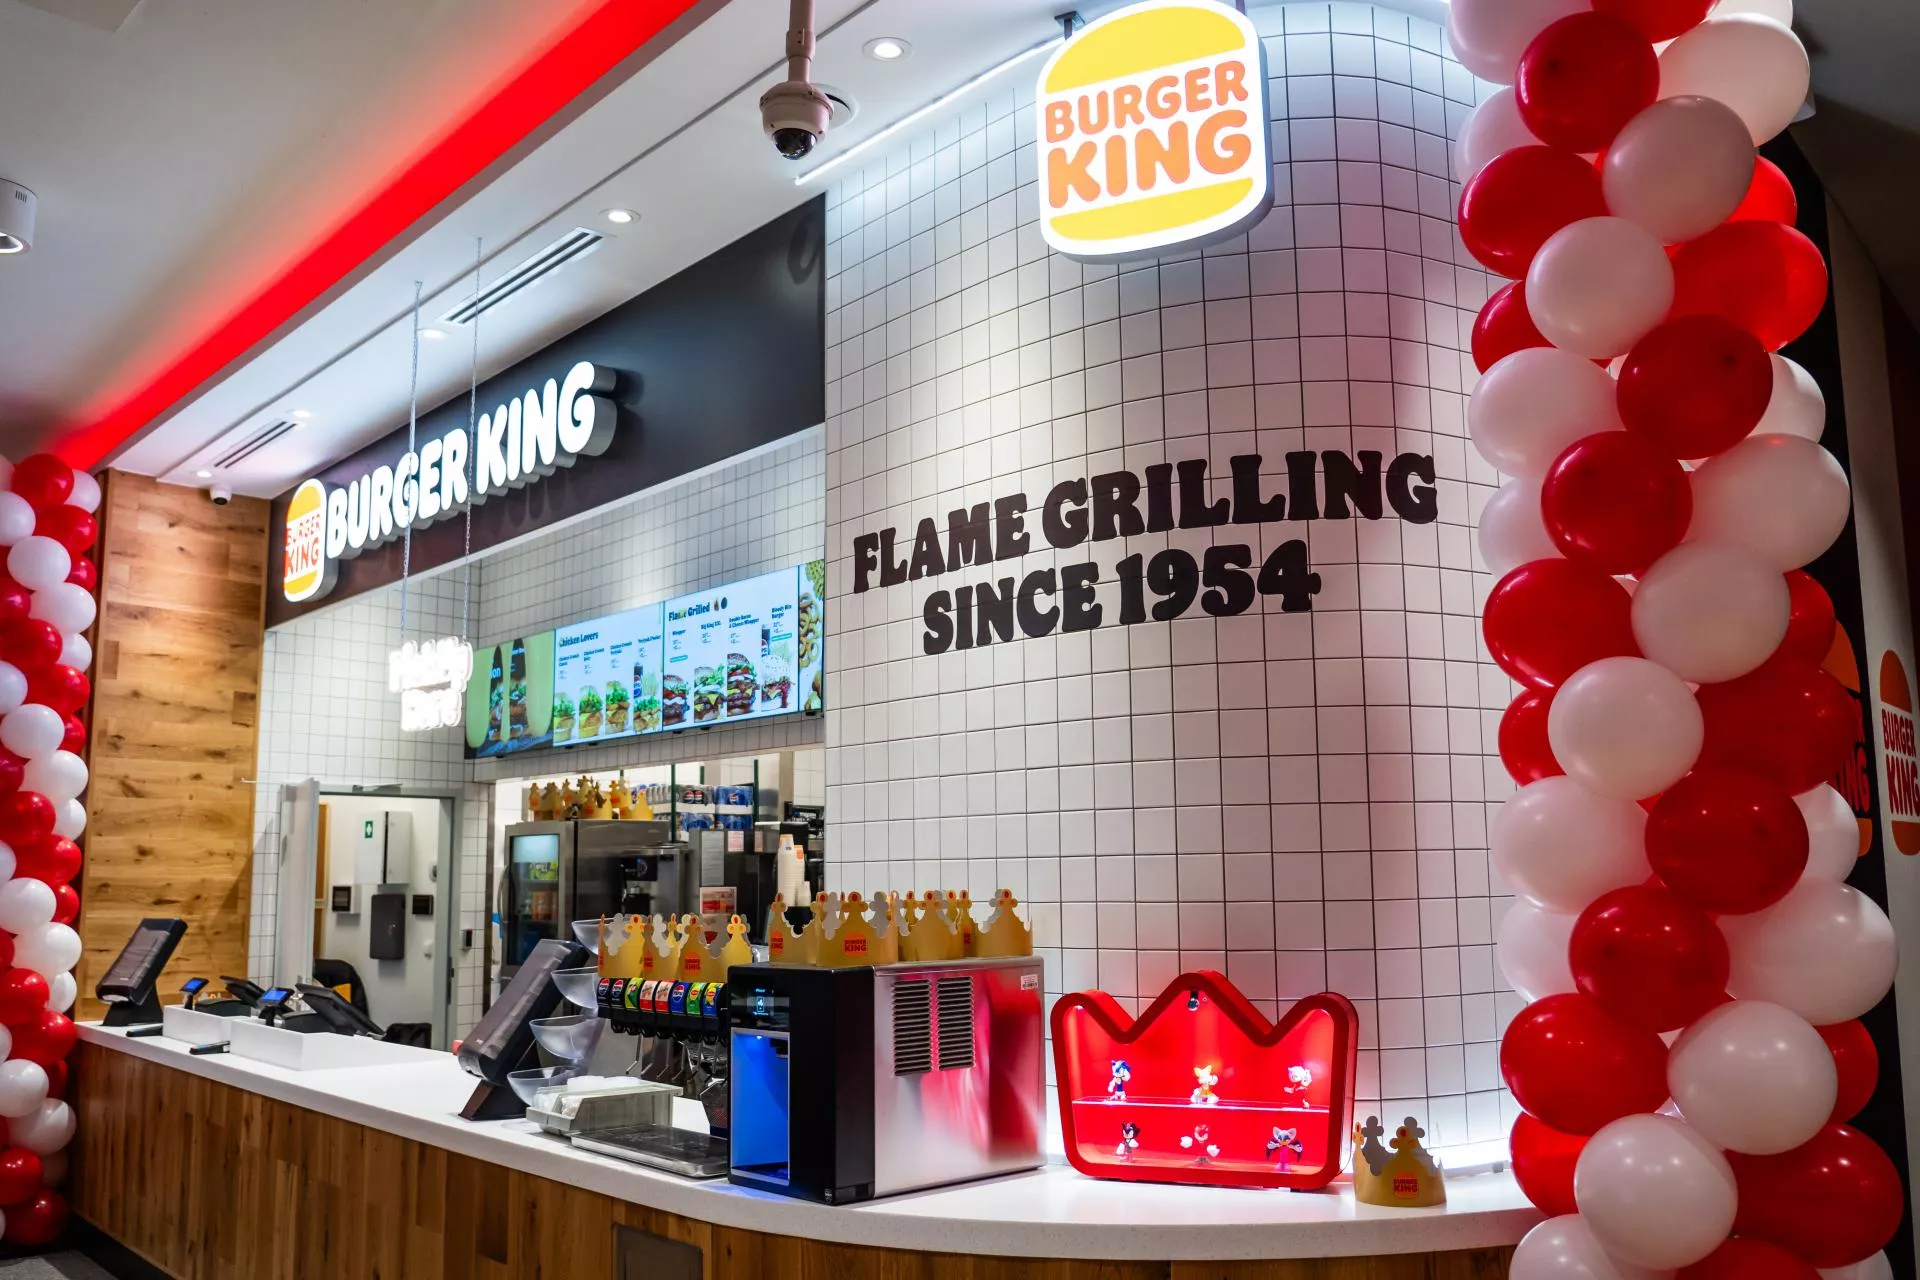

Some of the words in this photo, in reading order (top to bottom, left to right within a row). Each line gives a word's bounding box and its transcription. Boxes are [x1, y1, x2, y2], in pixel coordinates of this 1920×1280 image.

[1045, 60, 1248, 143] BURGER
[1047, 109, 1251, 208] KING
[326, 428, 469, 559] BURGER
[477, 360, 596, 495] KING
[284, 513, 320, 547] BURGER
[853, 493, 1030, 593] FLAME
[1042, 450, 1438, 548] GRILLING
[283, 537, 320, 577] KING
[687, 602, 710, 616] Grilled
[922, 561, 1102, 655] SINCE
[1115, 539, 1321, 625] 1954
[580, 632, 599, 643] Lovers
[1882, 708, 1916, 758] BURGER
[1886, 753, 1920, 817] KING
[844, 944, 867, 952] KING
[1393, 1184, 1418, 1193] KING
